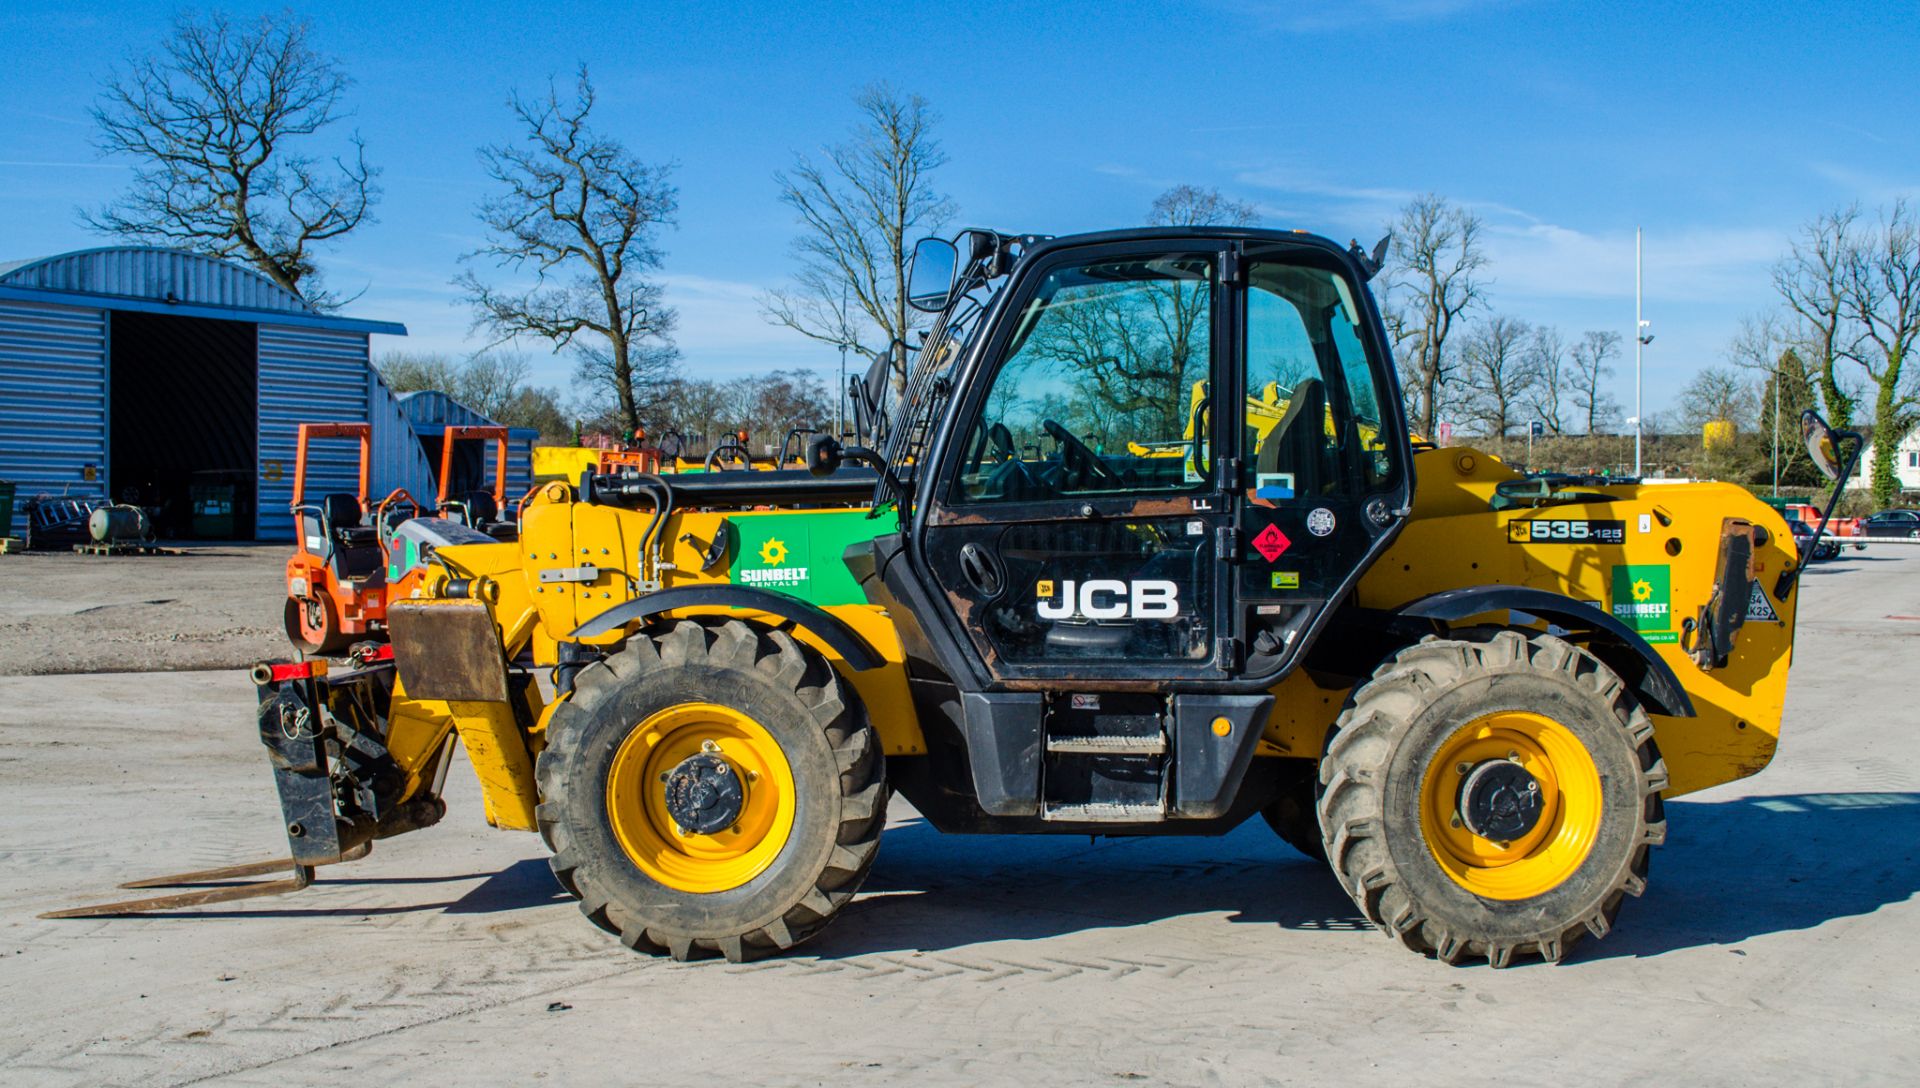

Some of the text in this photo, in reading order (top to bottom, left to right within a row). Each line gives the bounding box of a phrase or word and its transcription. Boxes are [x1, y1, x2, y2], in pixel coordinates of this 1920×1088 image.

[1532, 521, 1622, 538] 535-125
[741, 568, 809, 582] SUNBELT
[1037, 580, 1179, 619] JCB
[1614, 603, 1668, 615] SUNBELT
